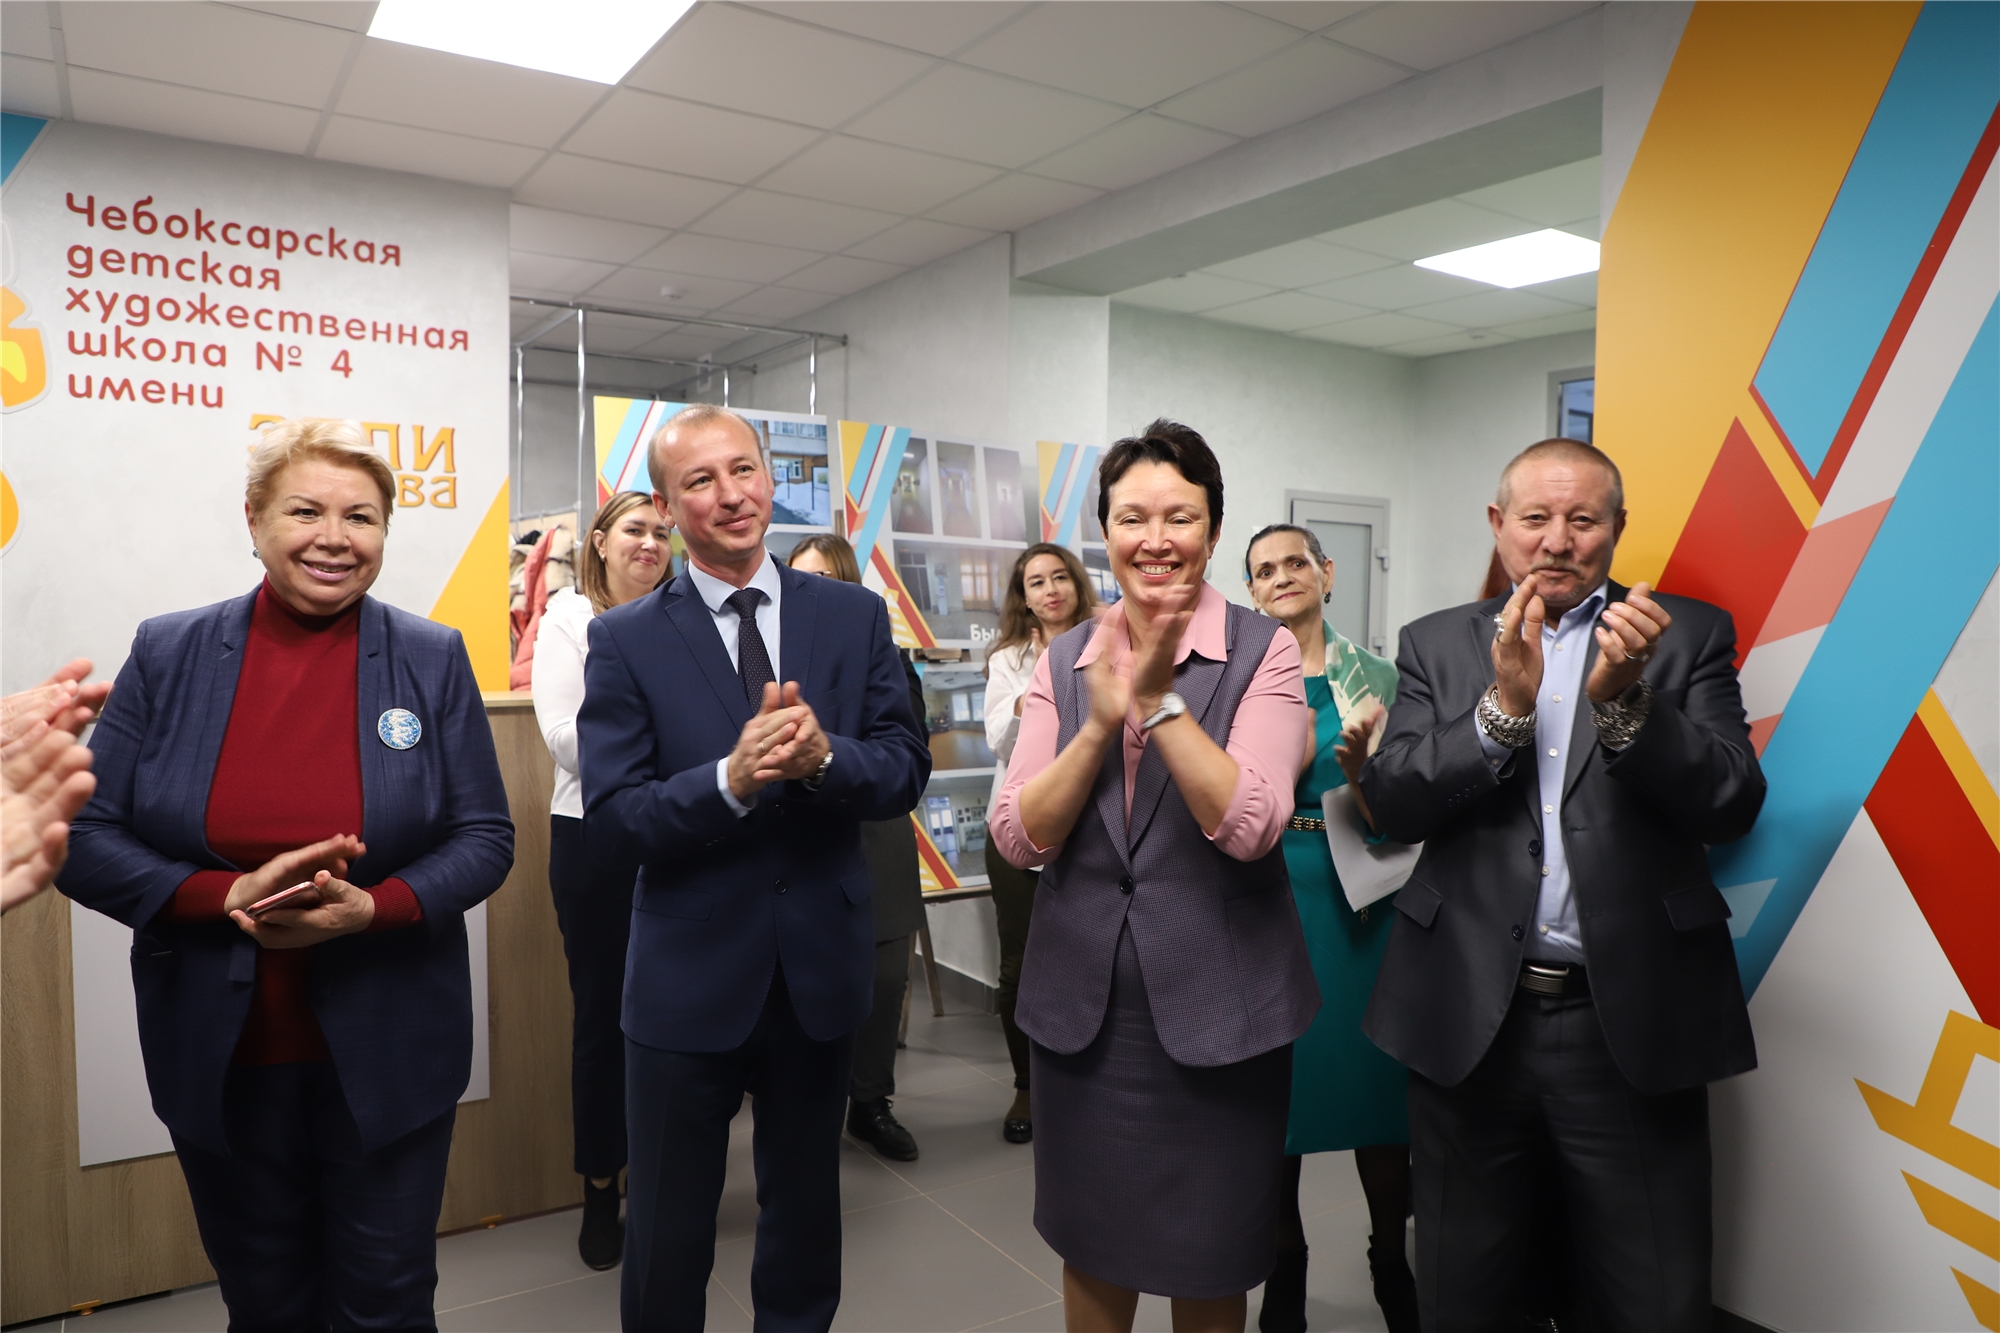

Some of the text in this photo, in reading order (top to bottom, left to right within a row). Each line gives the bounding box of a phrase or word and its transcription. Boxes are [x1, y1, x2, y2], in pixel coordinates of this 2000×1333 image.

[67, 193, 400, 266] Чебоксарская
[68, 245, 280, 291] детская
[66, 288, 469, 351] художественная
[68, 331, 353, 379] школа № 4
[68, 374, 224, 409] имени
